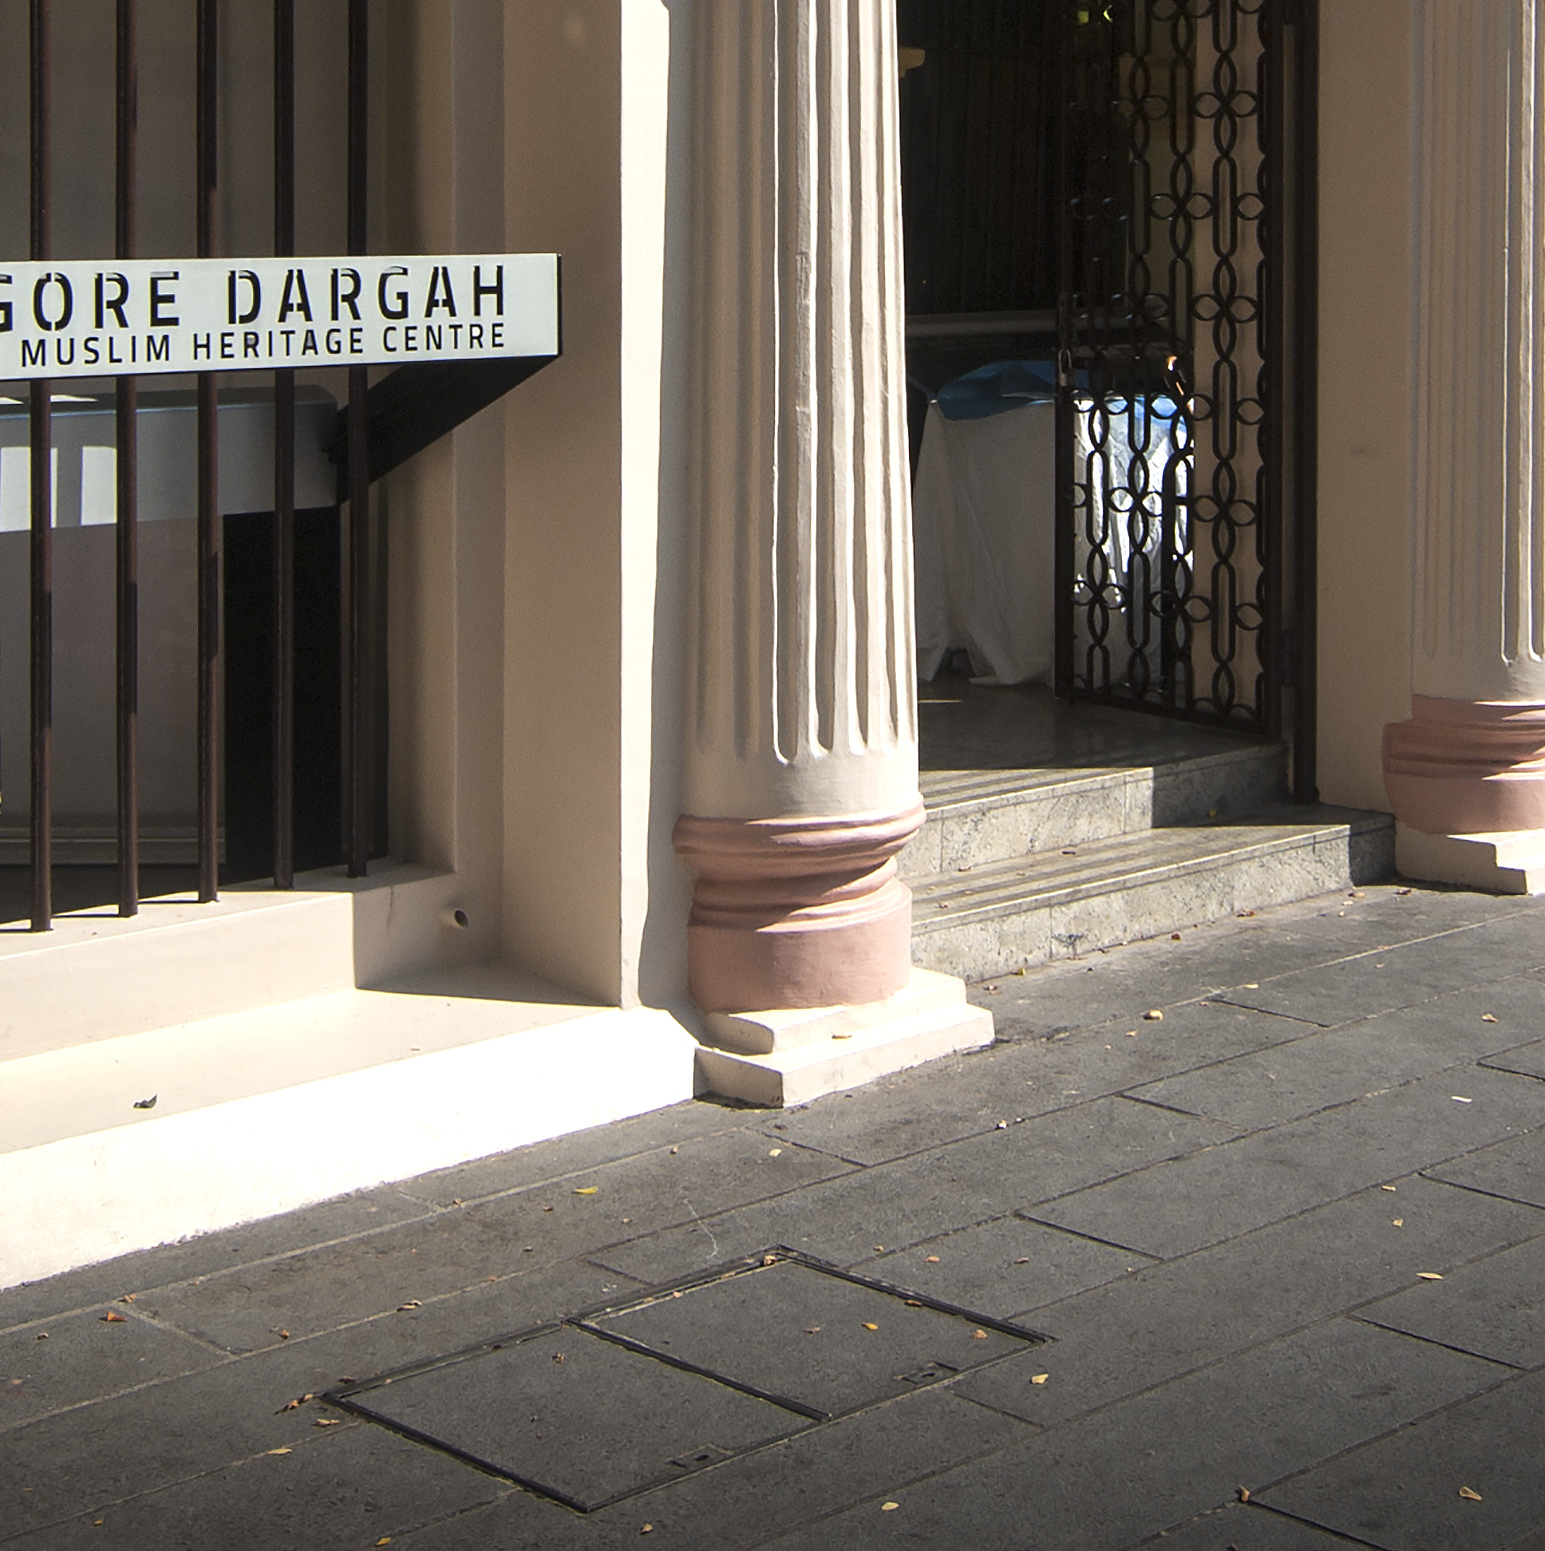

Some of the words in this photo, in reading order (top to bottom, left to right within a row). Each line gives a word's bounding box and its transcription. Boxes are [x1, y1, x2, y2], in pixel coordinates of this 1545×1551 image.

[227, 265, 504, 325] DARGAH
[21, 334, 170, 367] MUSLIM
[193, 327, 363, 360] HERITAGE
[383, 322, 504, 353] CENTRE
